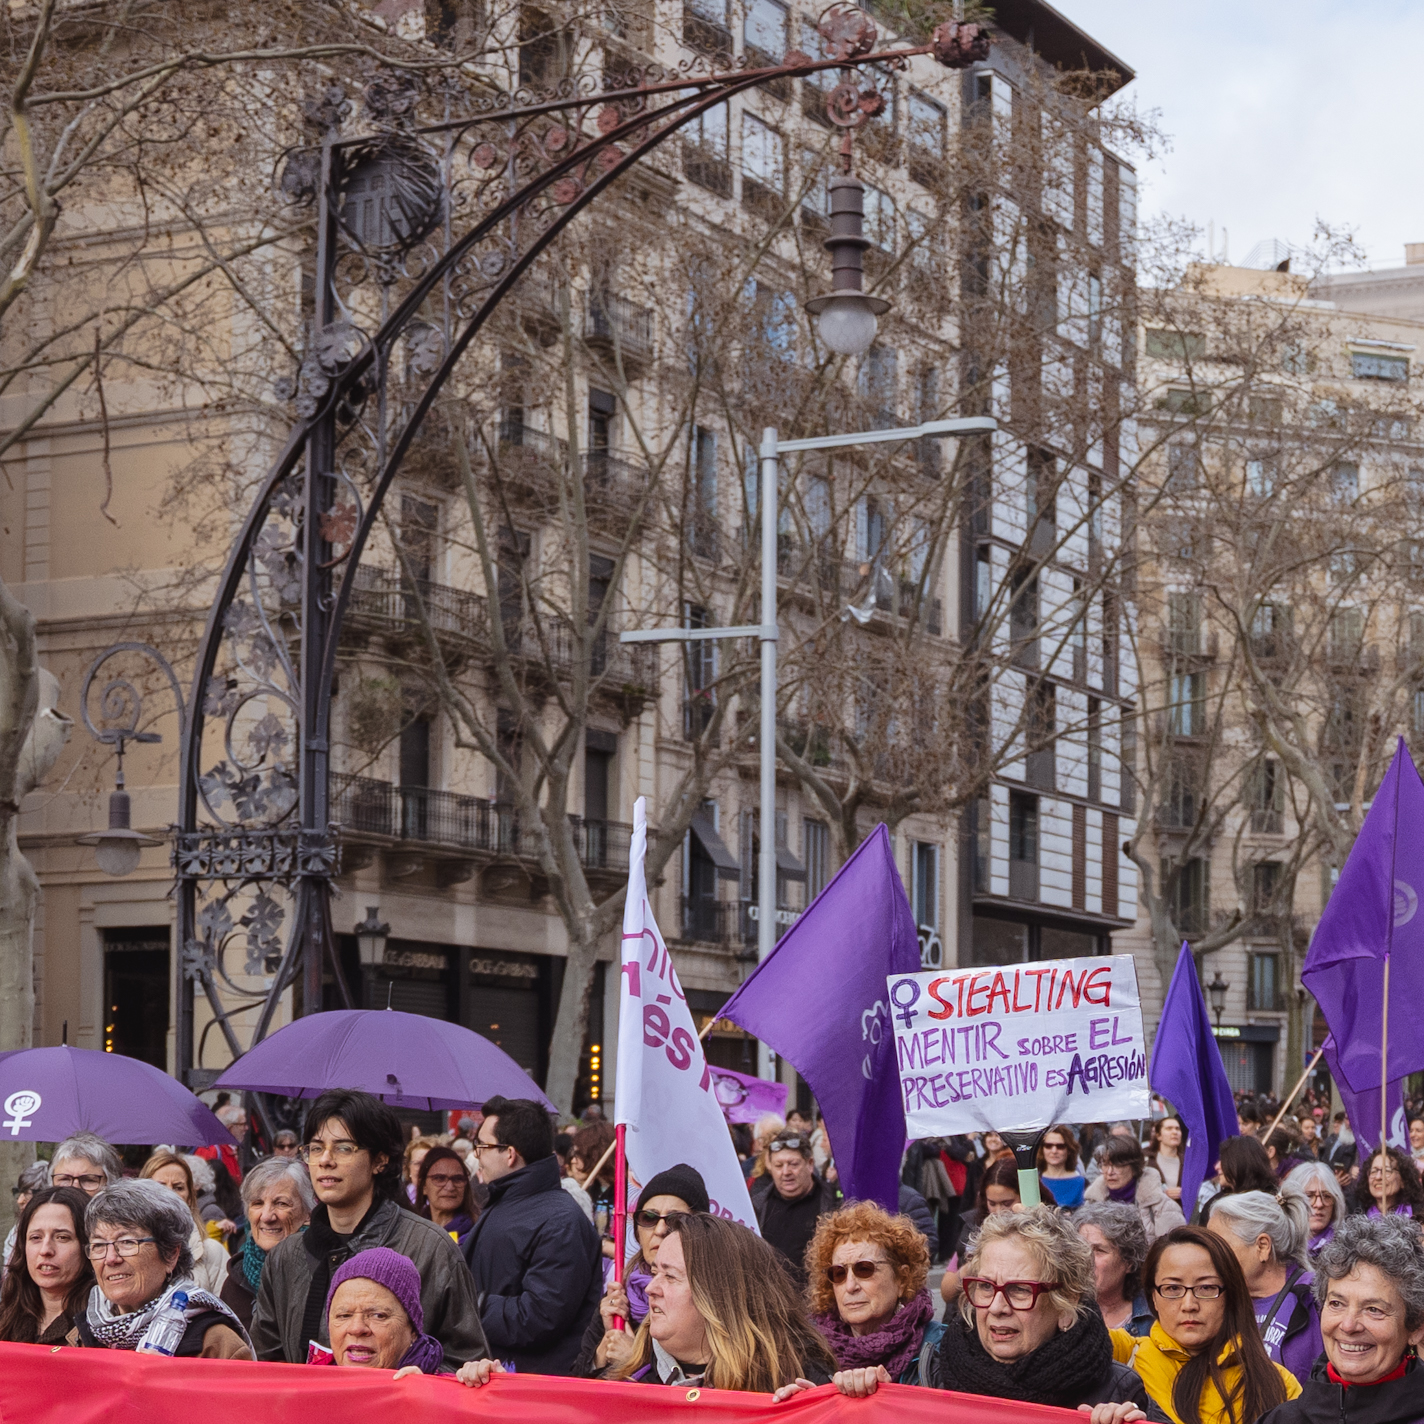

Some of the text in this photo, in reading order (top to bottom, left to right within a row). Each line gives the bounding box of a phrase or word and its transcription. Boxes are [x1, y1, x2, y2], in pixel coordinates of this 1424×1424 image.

[927, 967, 1112, 1020] STEALTING
[897, 1016, 1133, 1072] MENTIR SOBRE EL
[902, 1049, 1146, 1113] PRESERVATIVO ES AGRESIÓN
